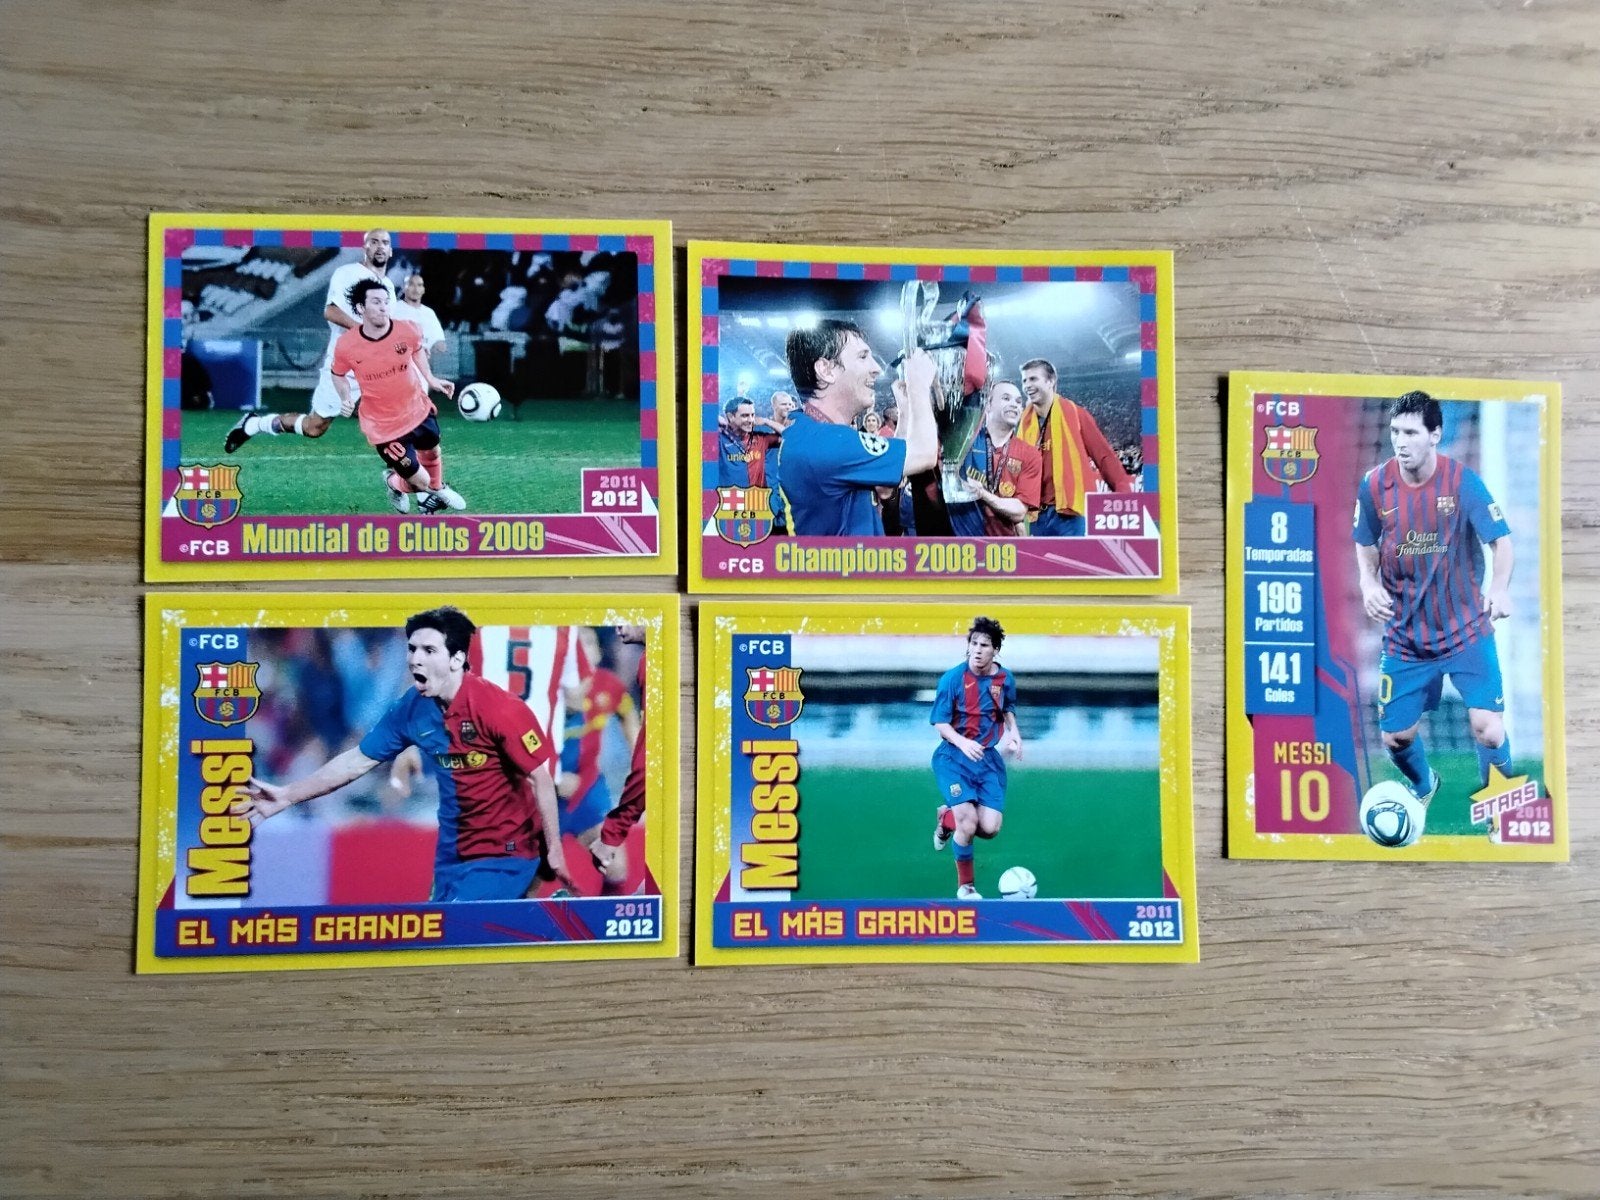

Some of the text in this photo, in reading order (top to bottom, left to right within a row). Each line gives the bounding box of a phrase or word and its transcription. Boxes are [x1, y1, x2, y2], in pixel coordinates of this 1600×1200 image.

[384, 441, 407, 461] 10
[600, 475, 636, 488] 2011
[195, 490, 222, 499] FCB
[591, 490, 638, 506] 2012
[1103, 500, 1138, 512] 2011
[1095, 514, 1140, 529] 2012
[1271, 511, 1288, 543] 8
[242, 521, 545, 554] Mundial de Clubs 2009
[1406, 529, 1439, 546] Qatar
[1245, 546, 1313, 563] Temporadas
[1395, 542, 1448, 558] Foundation
[775, 543, 1017, 576] Champions 2008-09
[1257, 581, 1302, 614] 196
[1255, 617, 1303, 632] Partidos
[507, 639, 532, 700] 5
[1259, 652, 1301, 684] 141
[215, 688, 240, 697] FCB
[763, 692, 786, 700] FCB
[1265, 688, 1295, 702] Goles
[1274, 741, 1332, 765] MESSI
[1280, 769, 1330, 822] 10
[1472, 783, 1537, 822] STARS
[186, 739, 253, 896] Messi
[740, 740, 799, 889] Messi
[1515, 806, 1549, 818] 2011
[1508, 821, 1551, 836] 2012
[615, 903, 652, 917] 2011
[1136, 905, 1172, 918] 2011
[178, 913, 443, 945] EL MÁS GRANDE
[605, 919, 653, 937] 2012
[734, 906, 976, 936] EL MÁS GRANDE
[1128, 921, 1175, 938] 2012
